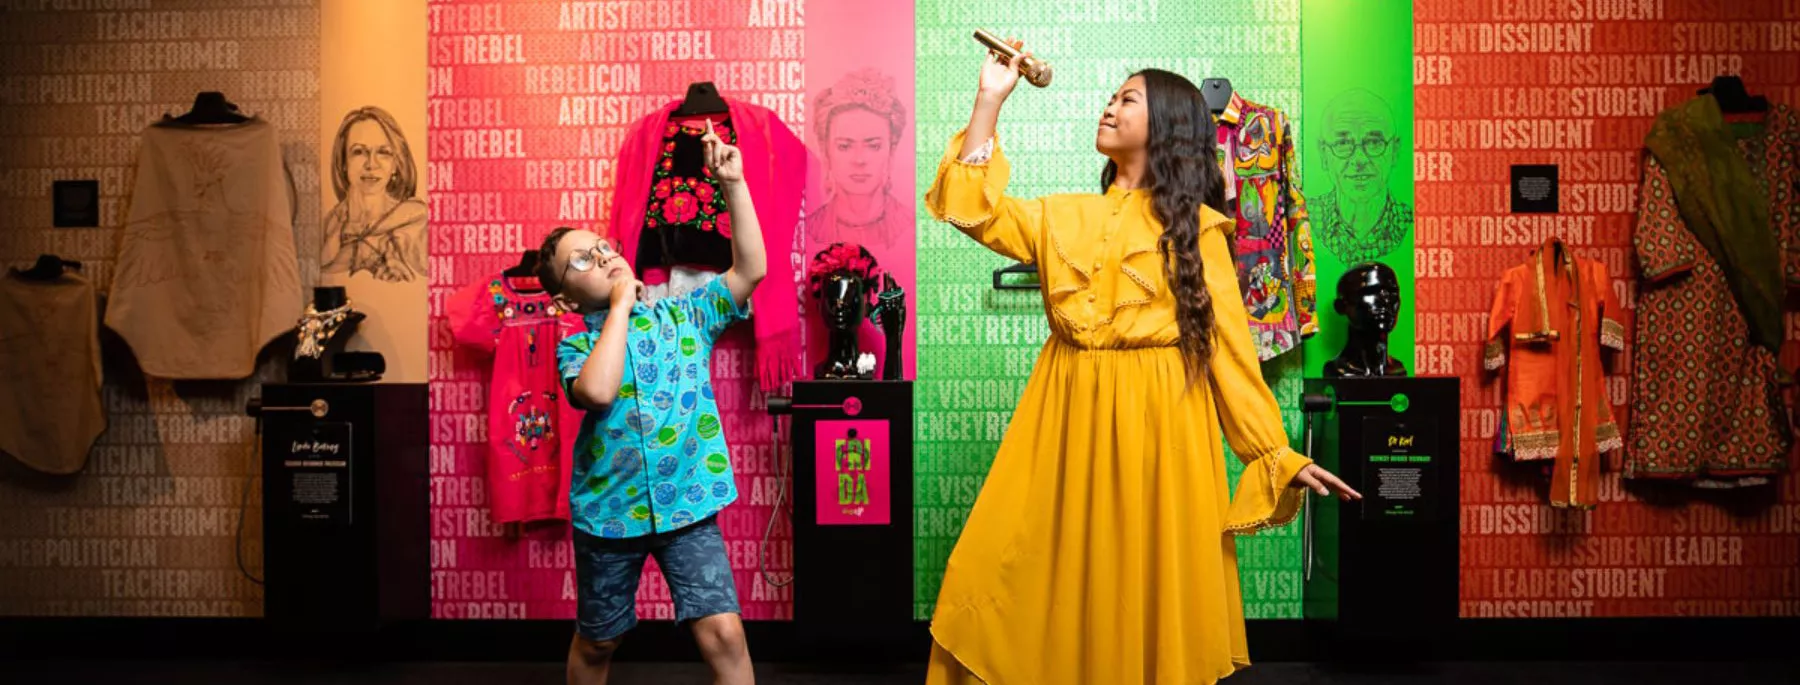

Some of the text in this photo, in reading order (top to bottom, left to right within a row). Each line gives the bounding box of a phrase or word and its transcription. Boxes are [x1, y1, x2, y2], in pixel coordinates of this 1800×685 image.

[443, 2, 505, 32] REBEL
[557, 1, 631, 31] ARTIST
[630, 0, 695, 30] REBEL
[463, 33, 526, 64] REBEL
[579, 32, 652, 62] ARTIST
[651, 30, 716, 60] REBEL
[1479, 23, 1594, 53] DISSIDENT
[1672, 22, 1768, 52] STUDENT
[525, 65, 588, 94] REBEL
[588, 64, 641, 93] ICON
[1549, 55, 1665, 85] DISSIDENT
[1663, 54, 1743, 84] LEADER
[40, 73, 151, 103] POLITICIAN
[1492, 87, 1572, 117] LEADER
[1571, 87, 1668, 117] STUDENT
[442, 96, 505, 127] REBEL
[558, 96, 631, 126] ARTIST
[463, 128, 526, 159] REBEL
[1480, 119, 1594, 149] DISSIDENT
[526, 160, 588, 189] REBEL
[1414, 152, 1453, 182] DER
[443, 192, 506, 222] REBEL
[463, 223, 527, 253] REBEL
[1480, 216, 1595, 246] DISSIDENT
[1414, 248, 1454, 278] DER
[1414, 345, 1454, 375] DER
[101, 477, 188, 505] TEACHER
[46, 538, 157, 567] POLITICIAN
[1664, 536, 1743, 566] LEADER
[102, 570, 190, 598] TEACHER
[446, 571, 509, 600] REBEL
[1493, 568, 1572, 598] LEADER
[1571, 568, 1668, 598] STUDENT
